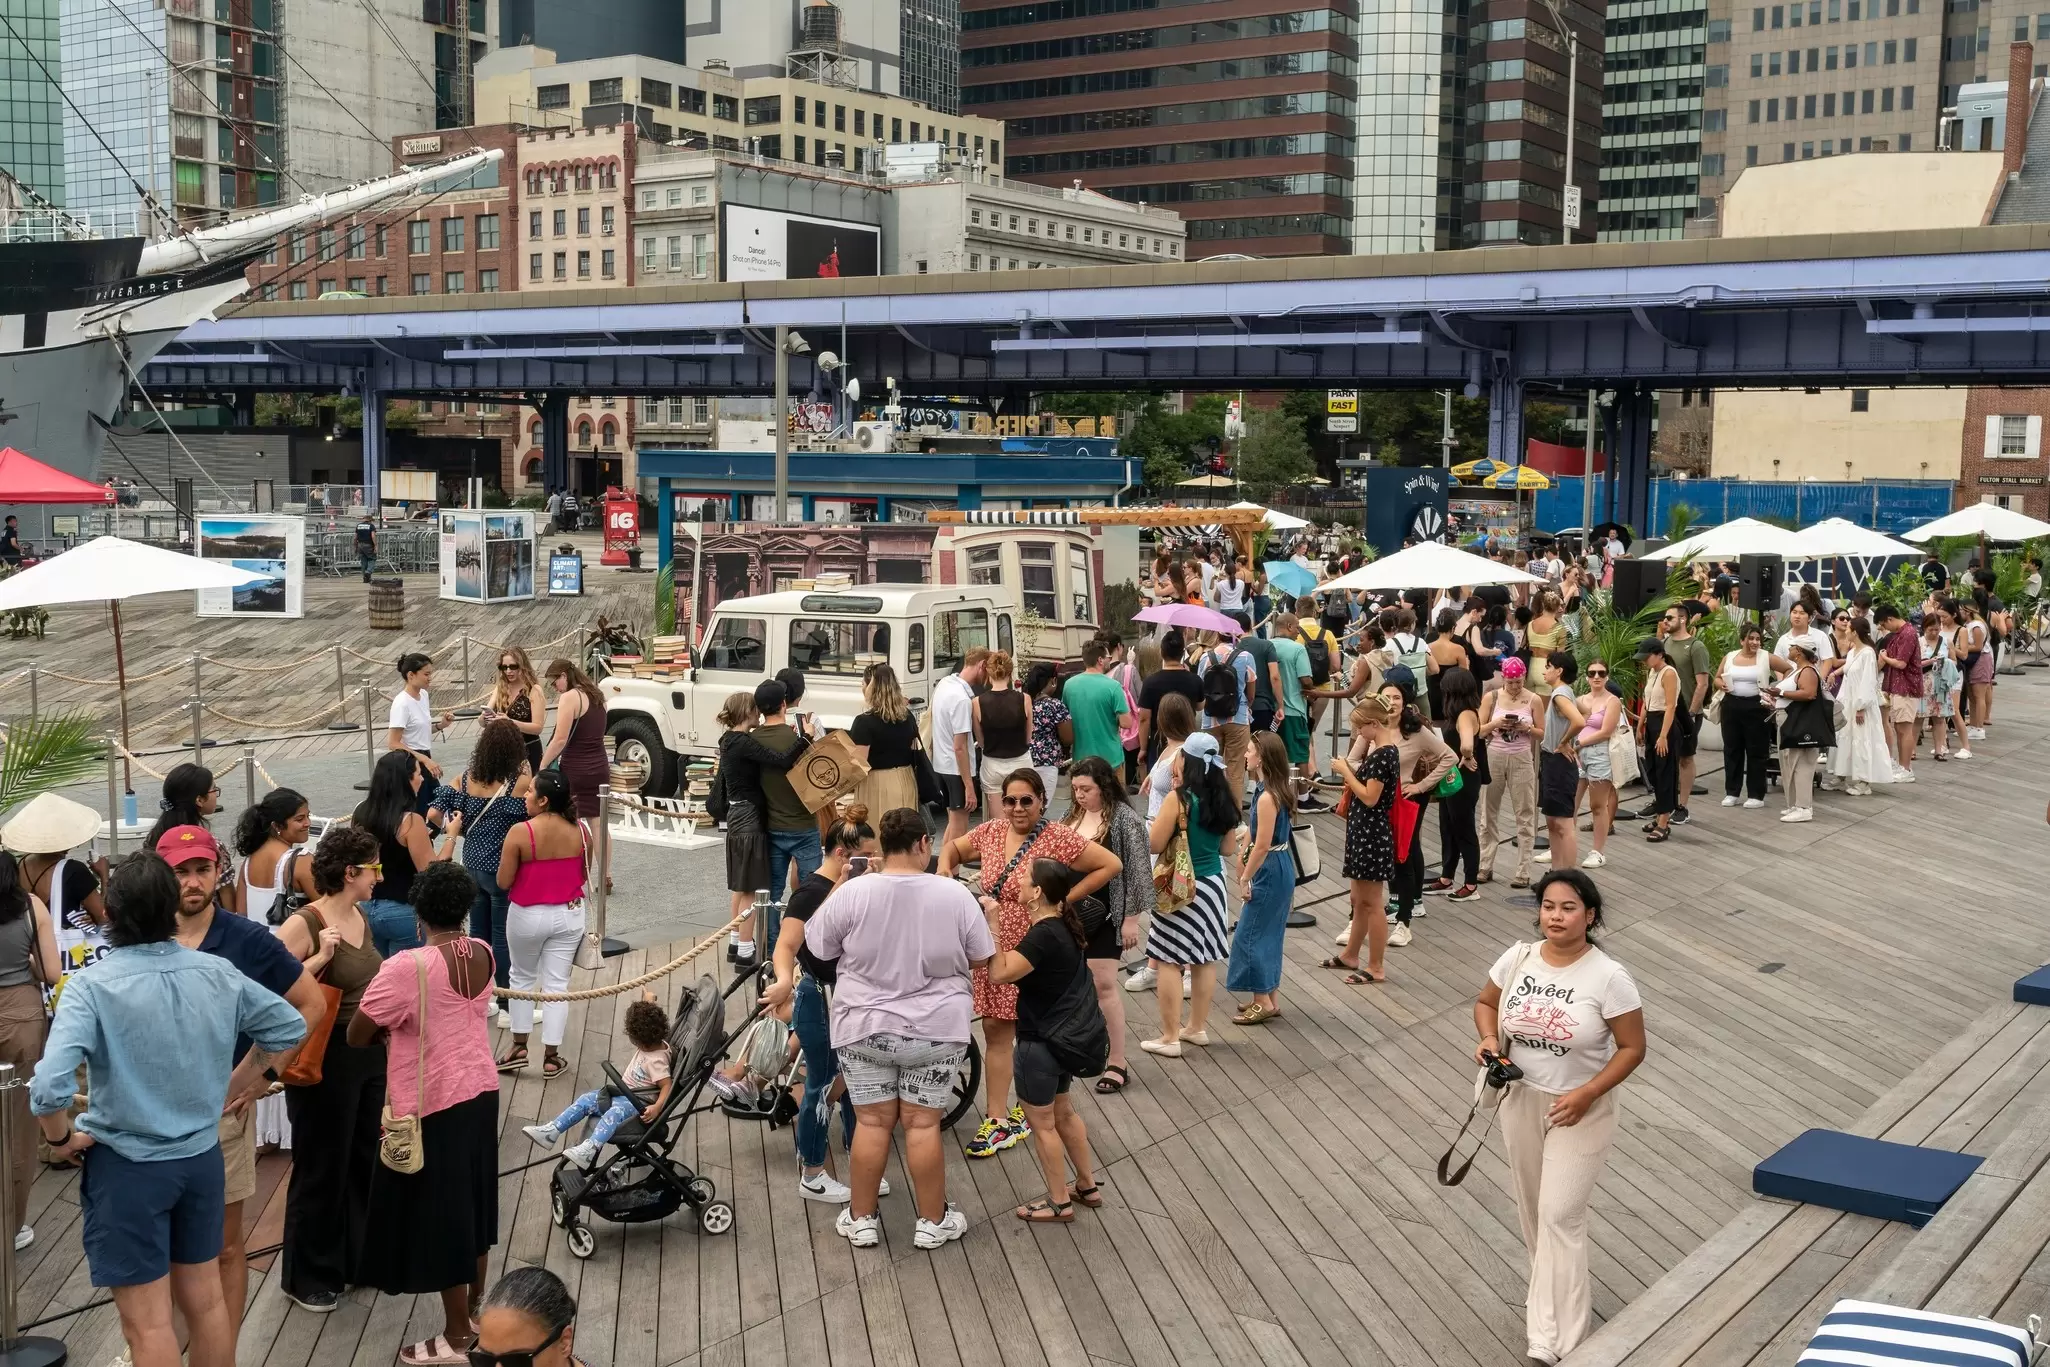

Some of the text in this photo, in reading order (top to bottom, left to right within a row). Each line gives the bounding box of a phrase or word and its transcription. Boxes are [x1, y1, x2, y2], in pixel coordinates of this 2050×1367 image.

[1566, 187, 1578, 195] SPEED
[1567, 205, 1577, 217] 30
[748, 246, 766, 255] Dance!
[732, 254, 744, 263] Shot
[750, 256, 767, 265] iPhone
[1331, 390, 1355, 398] PARK
[1331, 401, 1354, 410] FAST
[1404, 474, 1440, 495] Spin & Win!
[610, 512, 635, 529] 16
[1516, 975, 1575, 1005] Sweet
[1506, 996, 1521, 1010] &
[1512, 1033, 1572, 1057] Spicy
